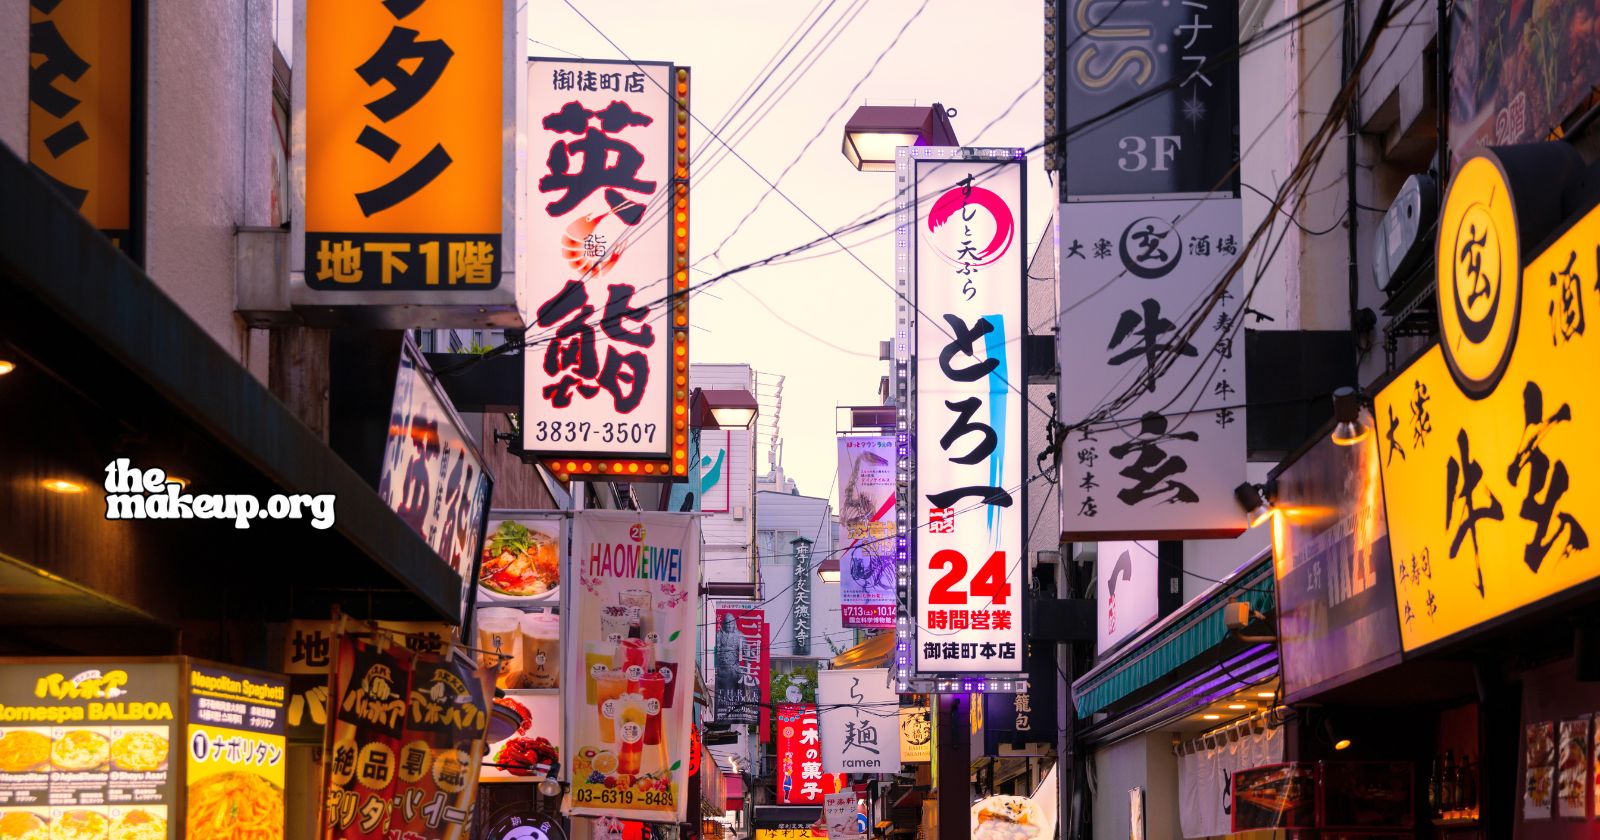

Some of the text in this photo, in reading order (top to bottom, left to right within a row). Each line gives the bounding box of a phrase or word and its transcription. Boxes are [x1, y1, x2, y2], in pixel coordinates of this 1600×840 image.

[552, 69, 646, 93] 御徒町店
[354, 0, 455, 217] タン
[1118, 135, 1182, 172] 3F
[316, 240, 495, 286] 地下1階
[536, 420, 657, 444] 3837-3507
[590, 543, 682, 582] HAOMEIWEI
[928, 549, 1012, 605] 24
[927, 610, 1012, 630] 時間営業
[923, 642, 1016, 659] 御徒町本店
[191, 671, 242, 693] Neapolitan
[242, 680, 285, 701] Spaghetti
[88, 702, 173, 720] BALBOA
[1014, 681, 1031, 731] 籠包
[212, 737, 282, 765] ナポリタン
[842, 759, 881, 768] ramen
